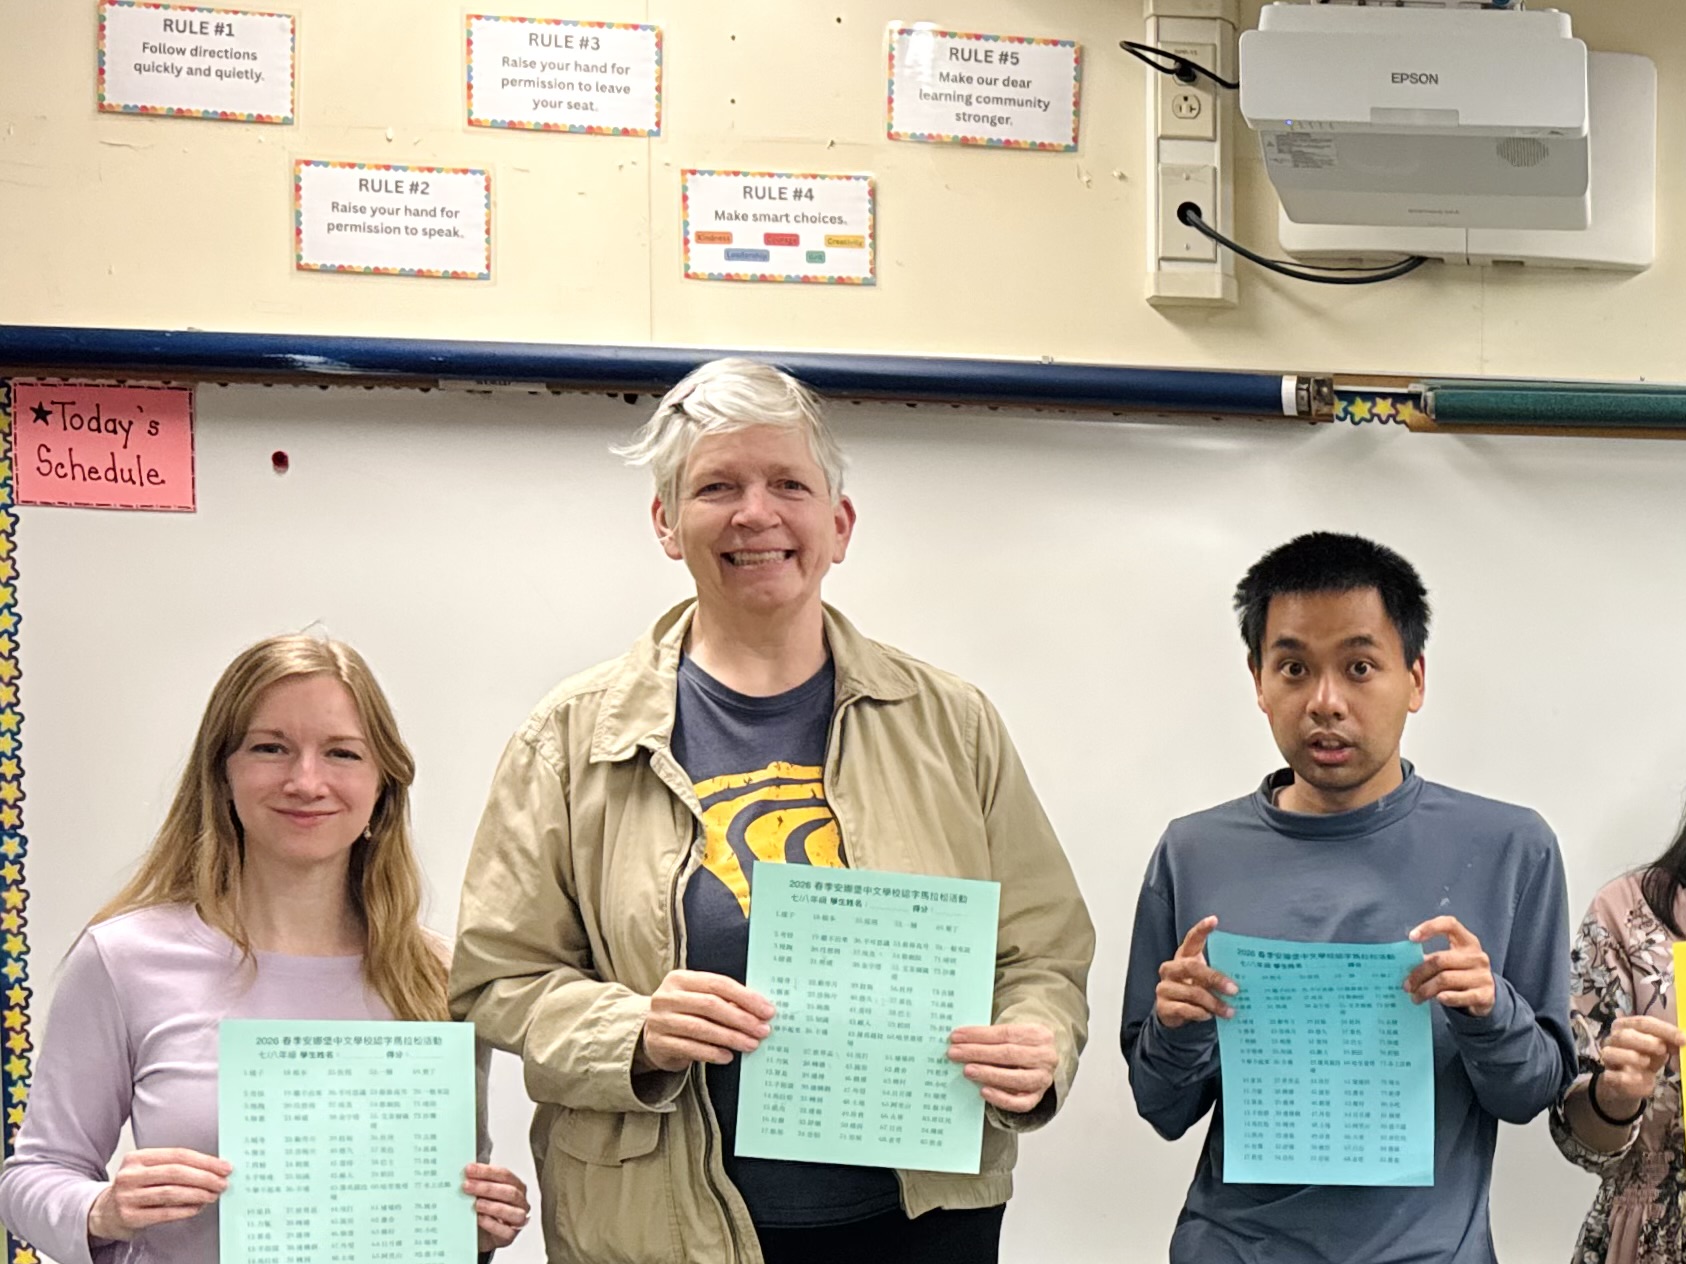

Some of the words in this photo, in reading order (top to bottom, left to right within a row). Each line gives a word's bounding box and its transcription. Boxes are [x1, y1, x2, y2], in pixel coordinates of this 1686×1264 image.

[163, 18, 209, 35] RULE
[214, 23, 235, 37] #1
[529, 33, 574, 49] RULE
[579, 36, 601, 51] #3
[142, 42, 187, 57] Follow
[190, 45, 258, 61] directions
[949, 47, 994, 64] RULE
[998, 51, 1020, 65] #5
[134, 61, 183, 77] quickly
[186, 66, 211, 77] and
[215, 67, 265, 83] quietly.
[502, 56, 537, 69] Raise
[540, 61, 570, 72] your
[574, 61, 607, 74] hand
[611, 63, 630, 75] for
[501, 77, 574, 91] permission
[578, 81, 592, 92] to
[596, 81, 631, 95] leave
[939, 71, 974, 85] Make
[977, 75, 999, 86] our
[1002, 76, 1032, 89] dear
[1391, 72, 1439, 86] EPSON
[532, 98, 563, 111] your
[567, 100, 599, 112] seat.
[919, 89, 972, 106] learning
[975, 94, 1051, 112] community
[955, 111, 1013, 127] stronger.
[359, 178, 404, 194] RULE
[409, 181, 430, 195] #2
[743, 185, 788, 200] RULE
[793, 187, 815, 201] #4
[331, 201, 367, 214] Raise
[370, 206, 401, 218] your
[404, 205, 436, 218] hand
[440, 207, 460, 219] for
[714, 210, 748, 222] Make
[752, 213, 790, 223] smart
[794, 213, 848, 225] choices.
[327, 221, 401, 235] permission
[404, 225, 418, 236] to
[421, 226, 464, 239] speak.
[51, 401, 160, 449] Today's
[36, 443, 166, 487] Schedule
[789, 879, 812, 890] 2026
[256, 1036, 280, 1046] 2026
